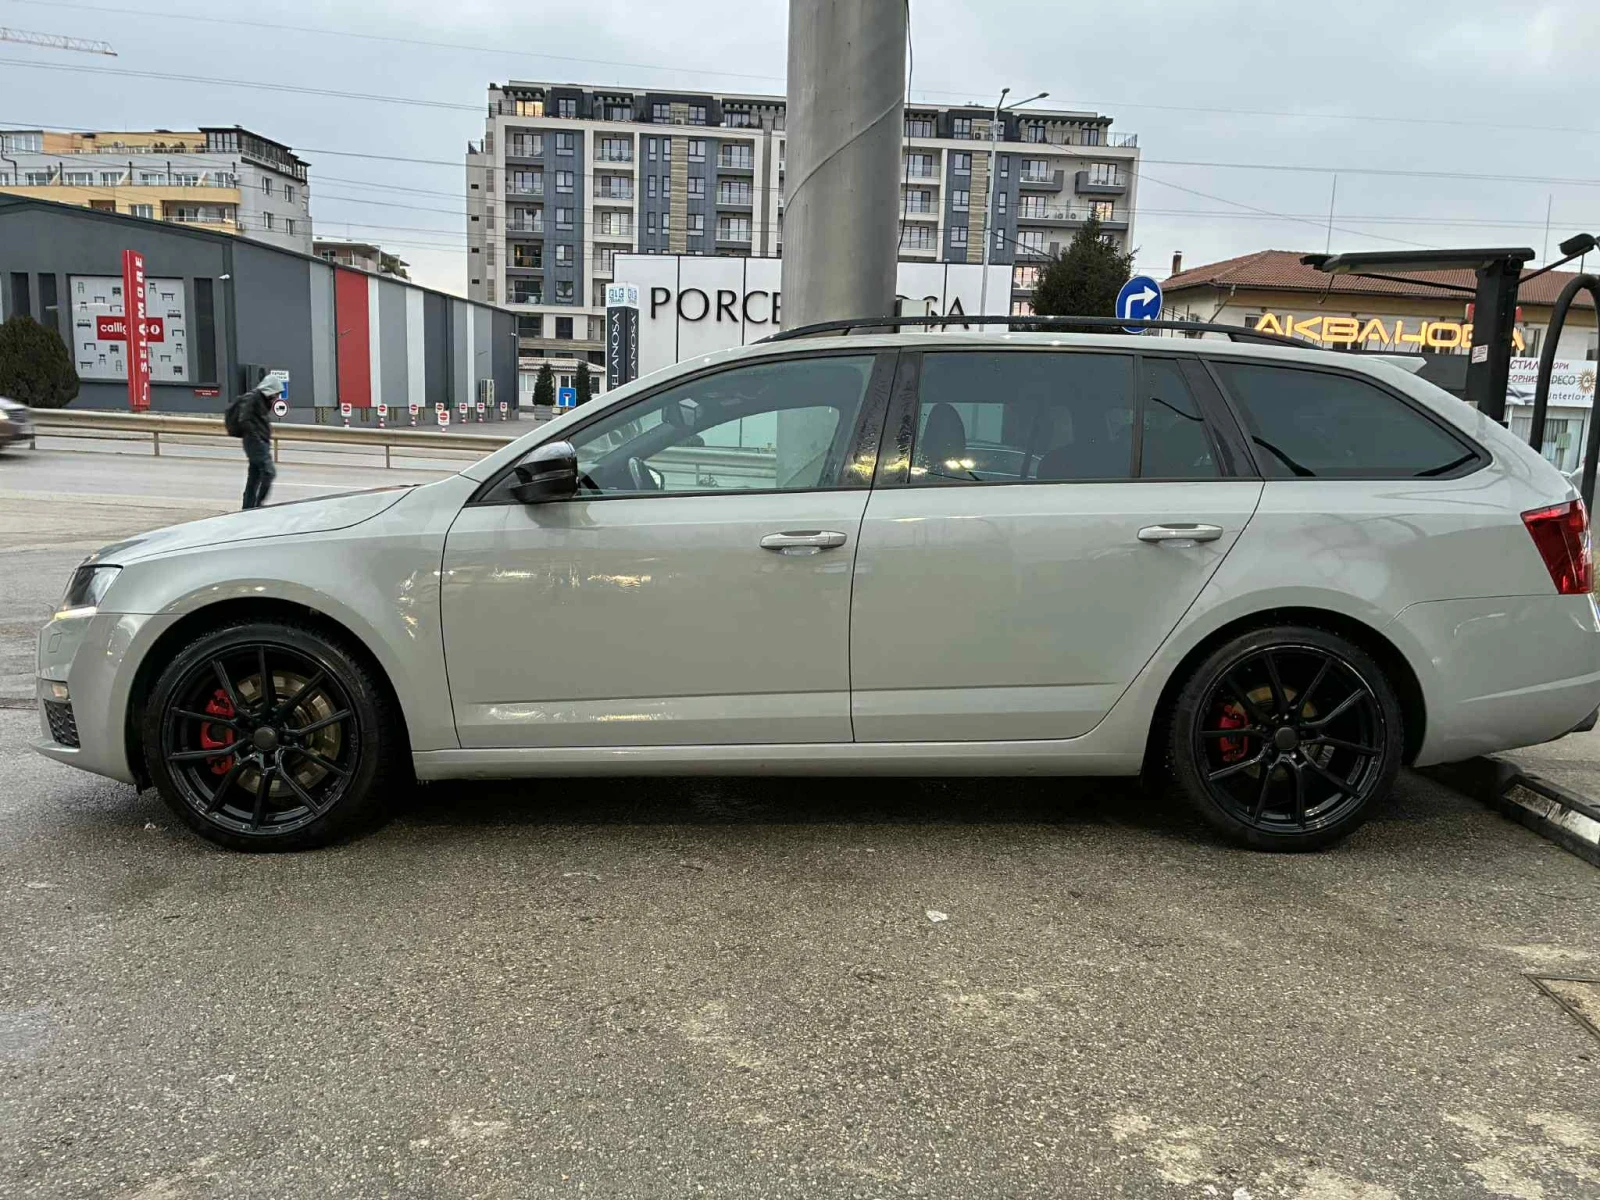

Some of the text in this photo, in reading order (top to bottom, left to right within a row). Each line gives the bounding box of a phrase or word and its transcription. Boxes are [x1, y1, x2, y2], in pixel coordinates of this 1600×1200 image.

[135, 256, 148, 373] SELAMORE
[611, 313, 620, 388] ELANOSA
[1510, 360, 1569, 370] СТИЛ ОРИ
[1551, 375, 1576, 385] DECO
